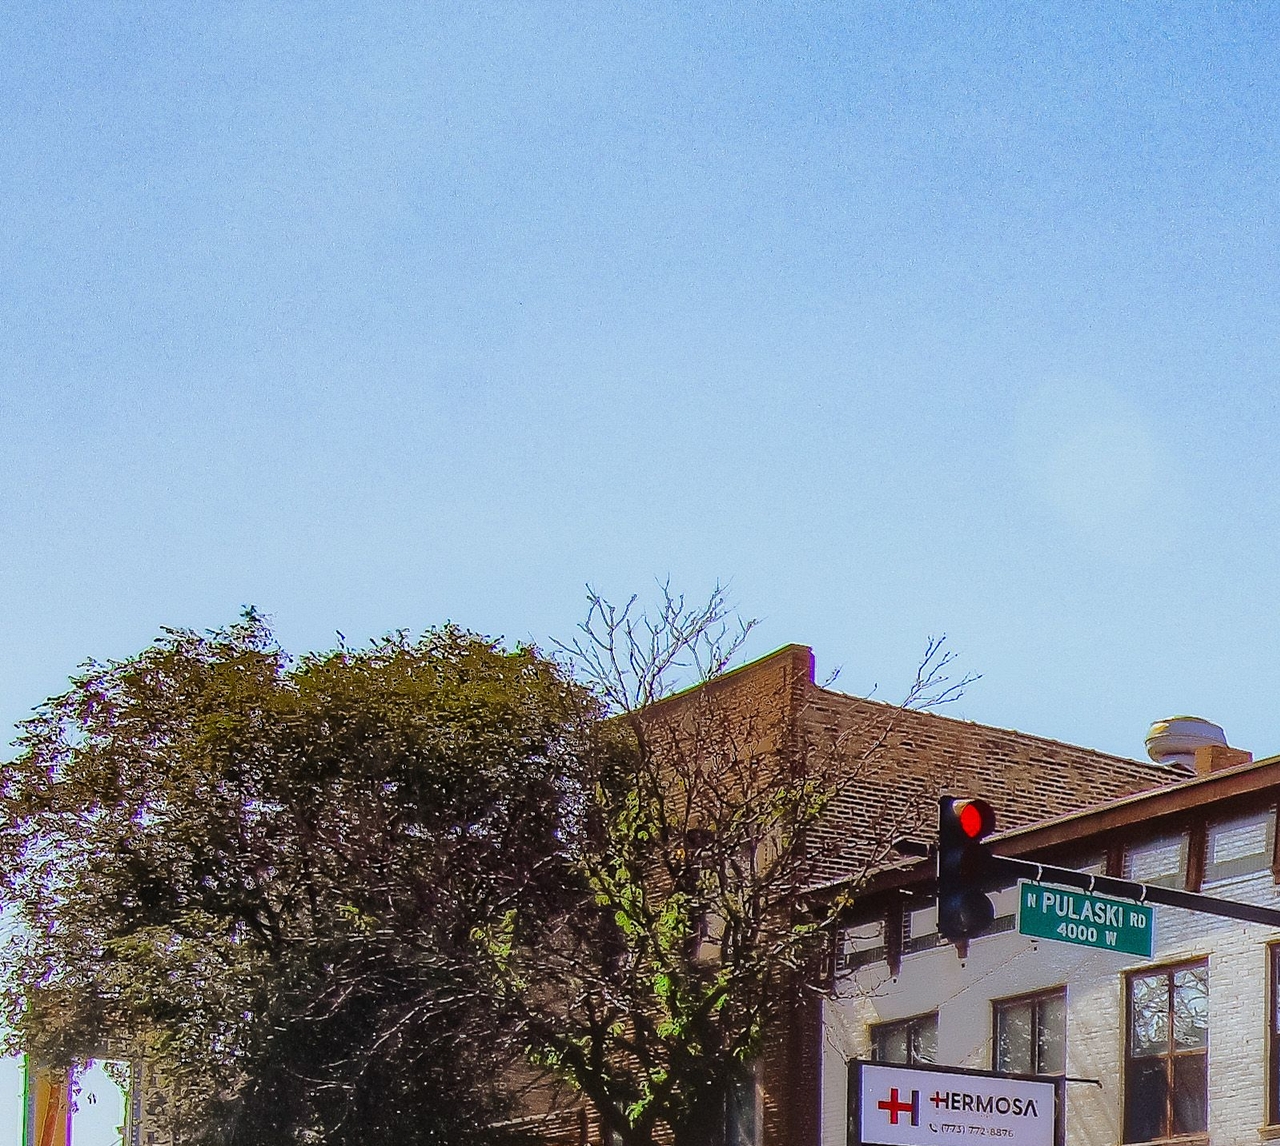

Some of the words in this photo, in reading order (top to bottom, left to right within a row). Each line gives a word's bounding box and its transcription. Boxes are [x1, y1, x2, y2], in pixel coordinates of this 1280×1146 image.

[1027, 894, 1037, 908] N
[1042, 892, 1124, 928] PULASKI
[1130, 912, 1147, 929] RD
[1056, 922, 1098, 943] 4000
[1106, 930, 1118, 947] W
[930, 1090, 1038, 1118] HERMOSA
